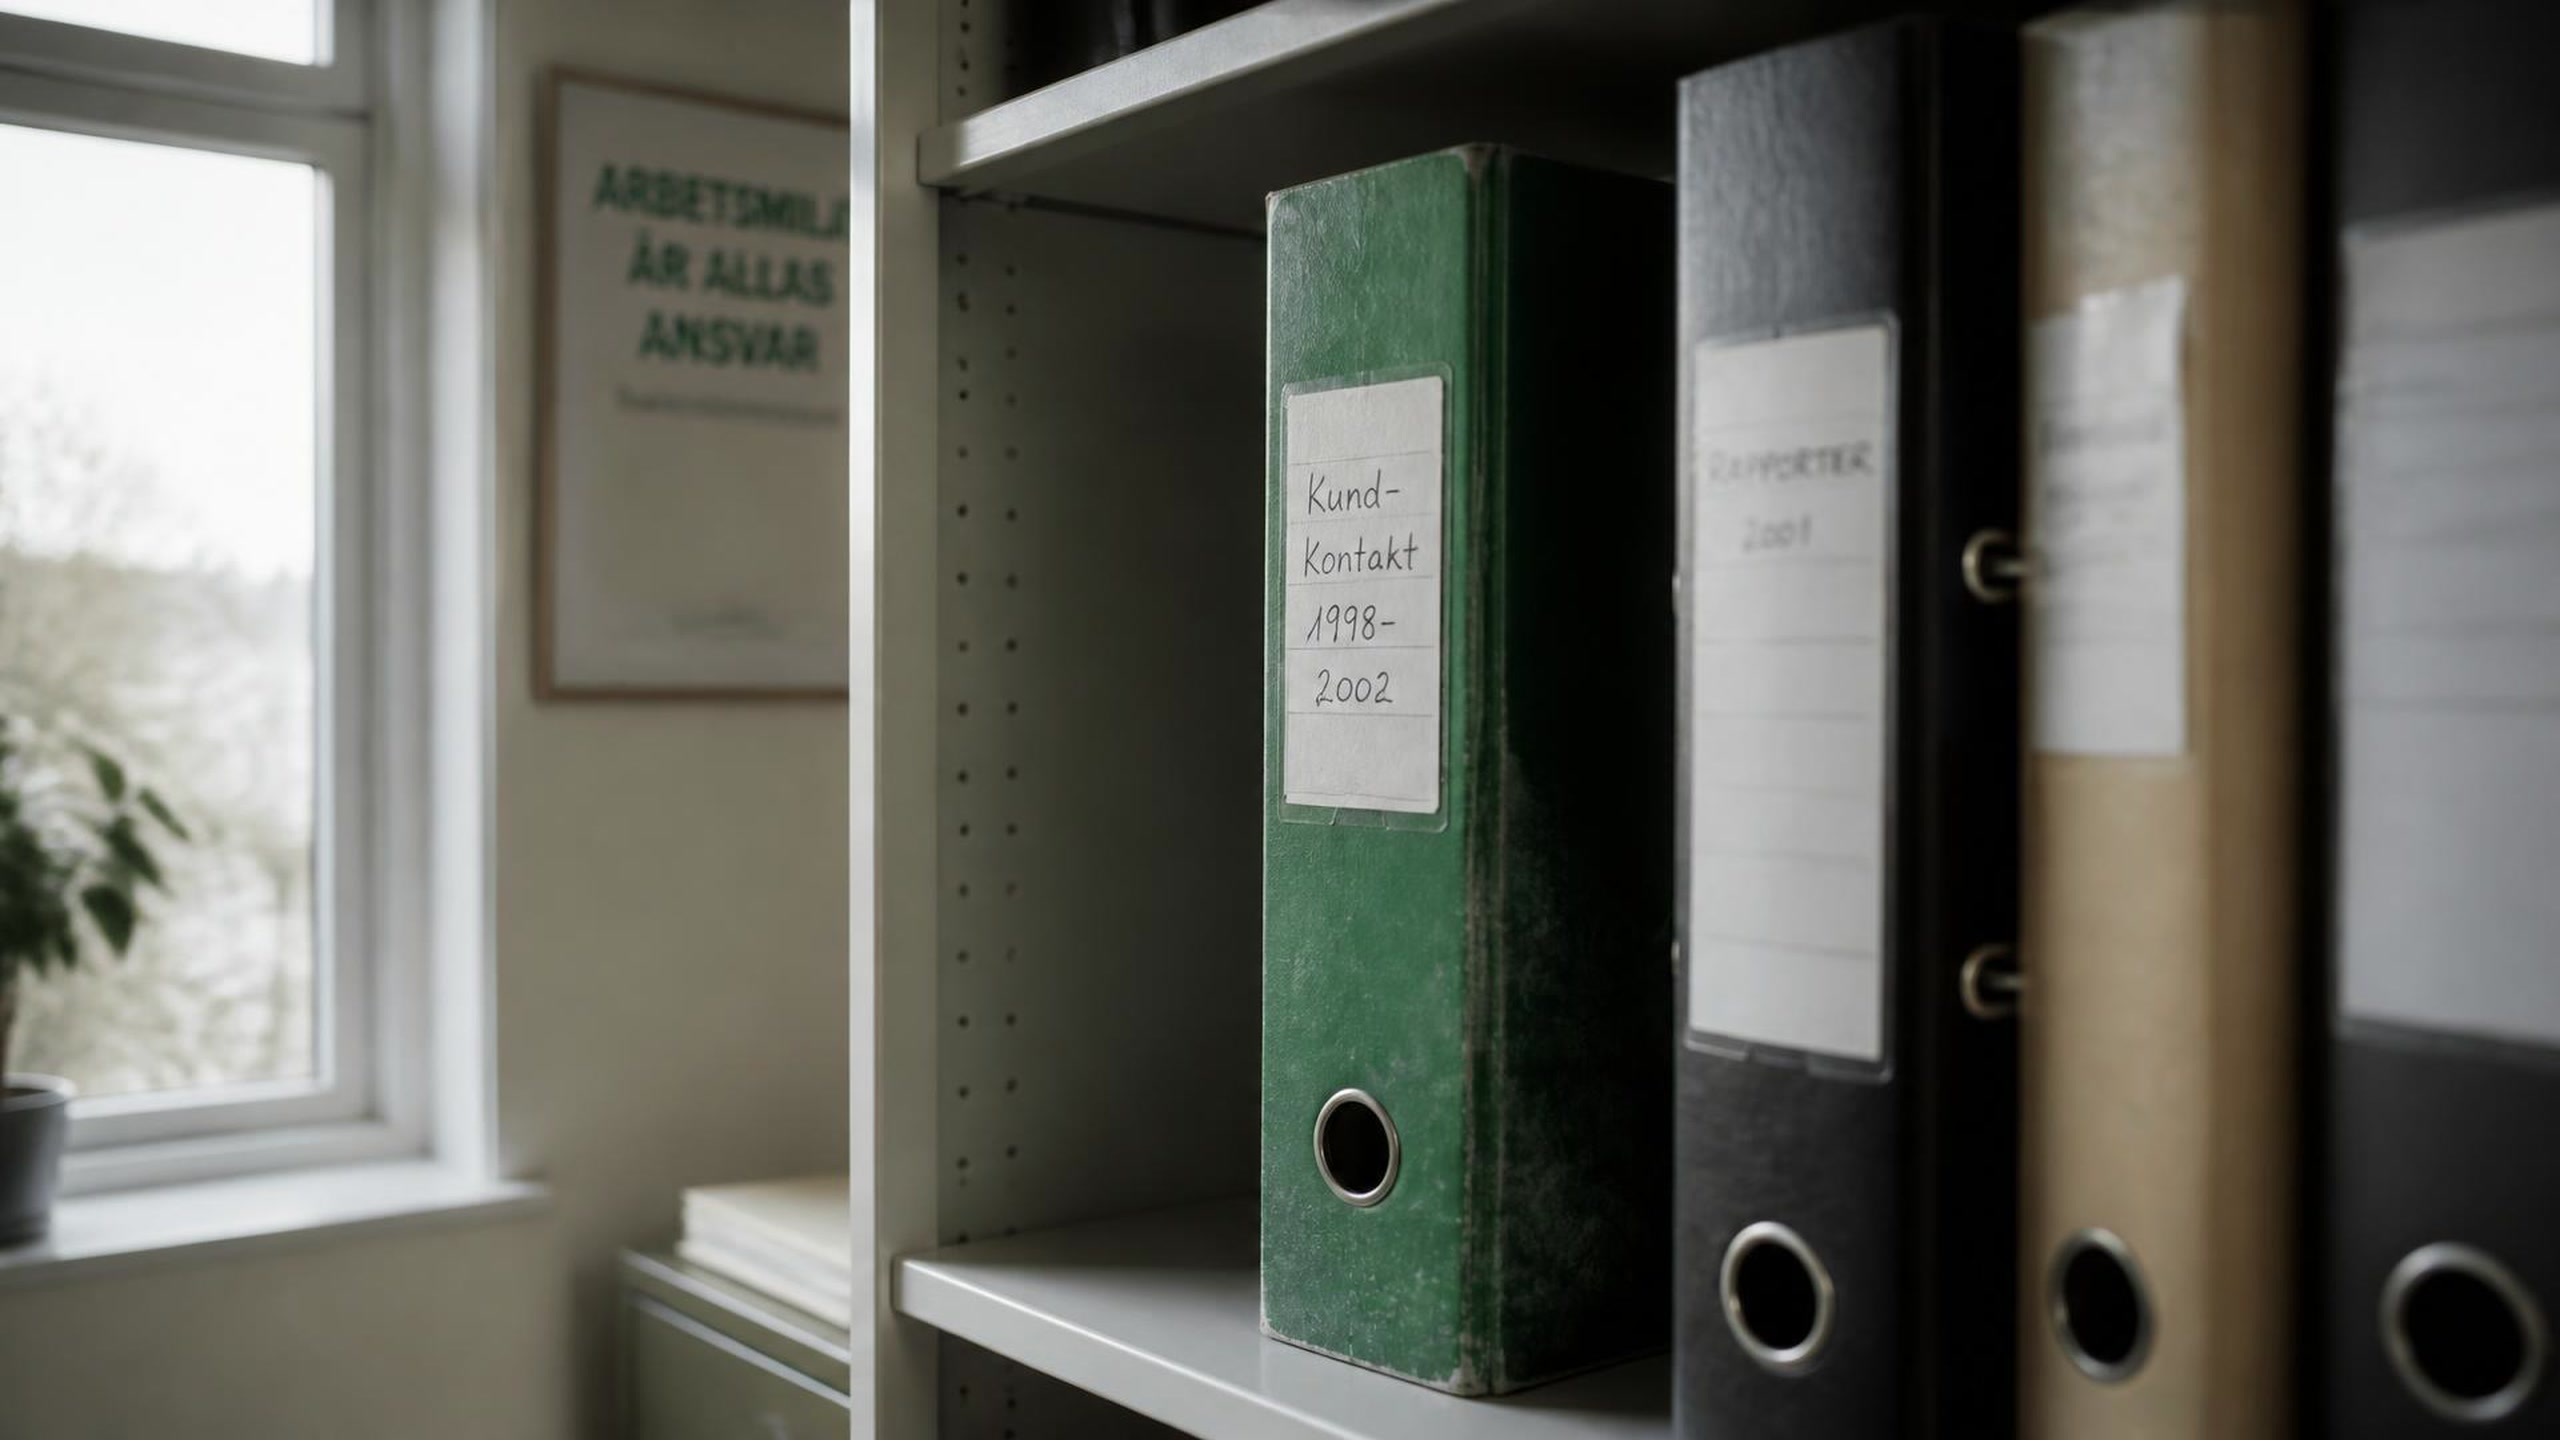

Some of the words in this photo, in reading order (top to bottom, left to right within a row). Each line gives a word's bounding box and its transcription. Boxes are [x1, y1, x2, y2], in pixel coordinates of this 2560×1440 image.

[702, 250, 835, 308] ALLAS
[638, 310, 822, 374] ANSVAR
[1307, 468, 1401, 515] Kund-
[1306, 604, 1397, 643] 1998-
[1315, 668, 1394, 707] 2002
